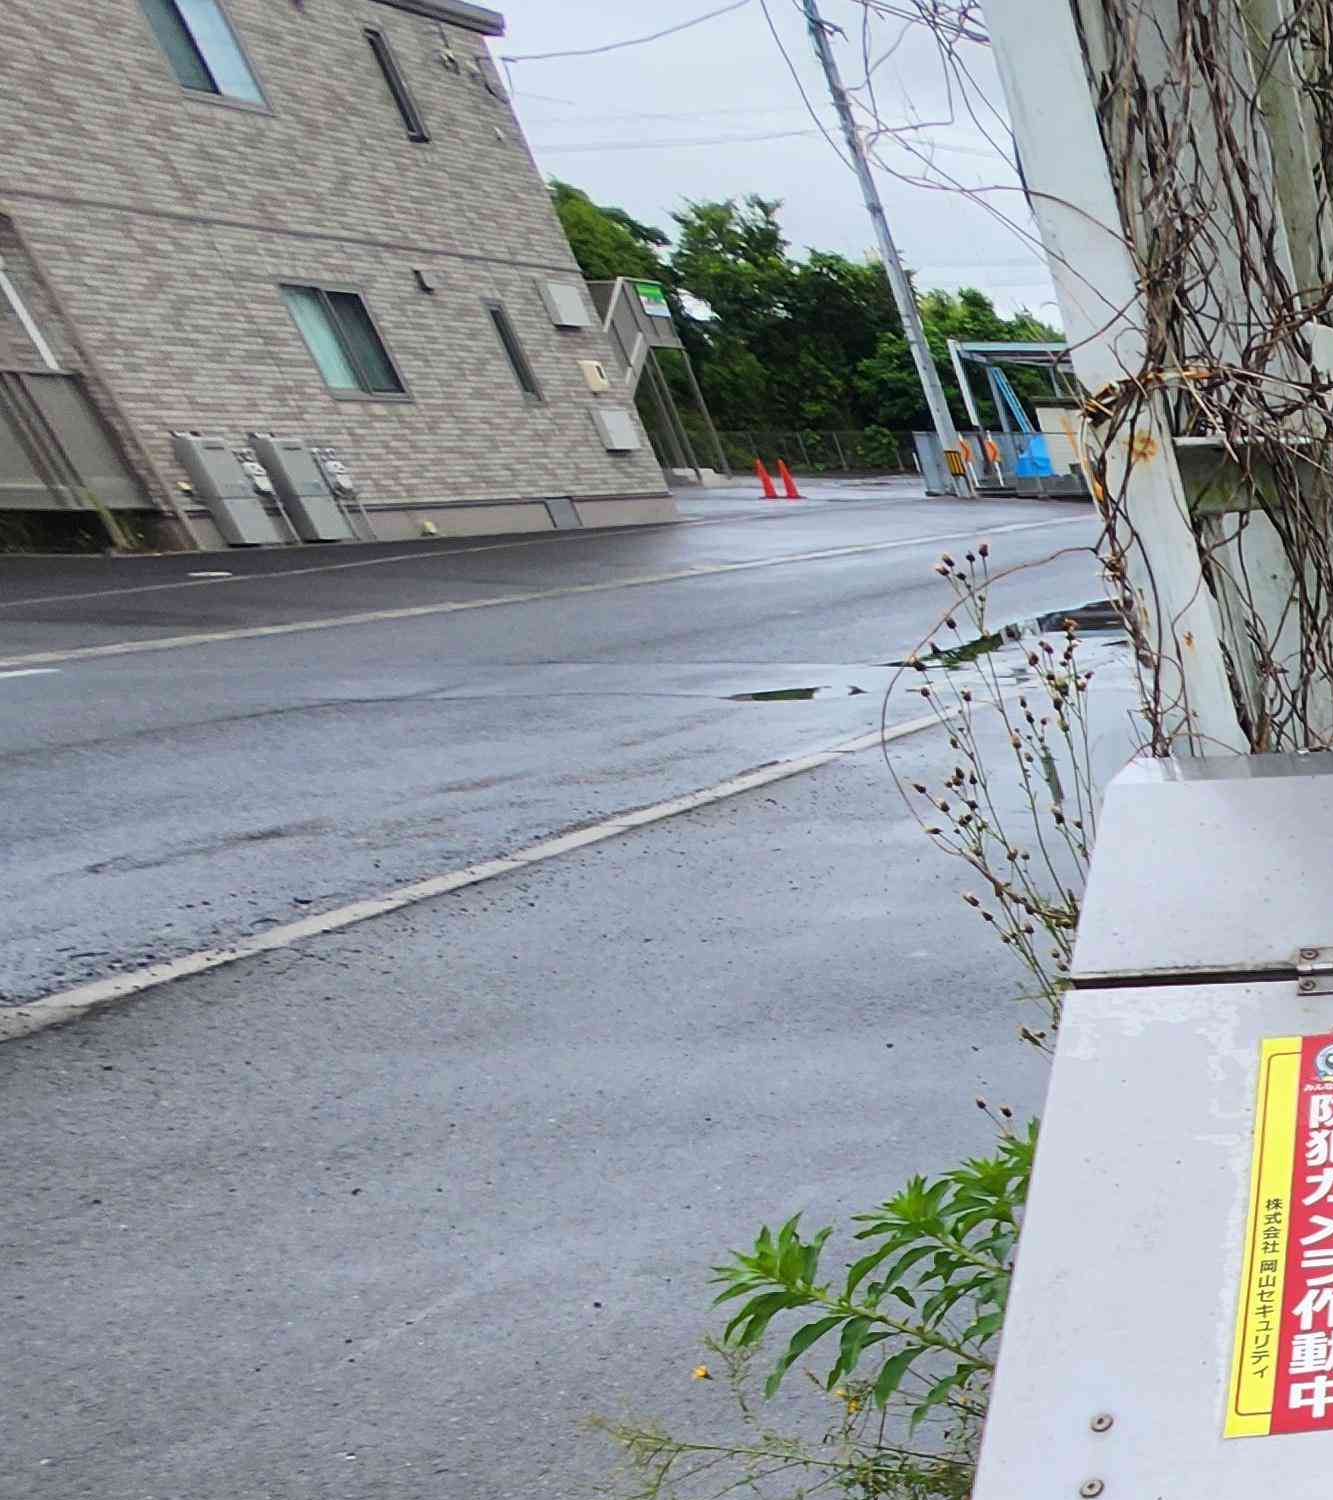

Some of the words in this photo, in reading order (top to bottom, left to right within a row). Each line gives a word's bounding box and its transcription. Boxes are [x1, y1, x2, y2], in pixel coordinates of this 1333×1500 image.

[1261, 1198, 1283, 1254] 株式会社
[1250, 1259, 1278, 1379] 岡山セキュリティ
